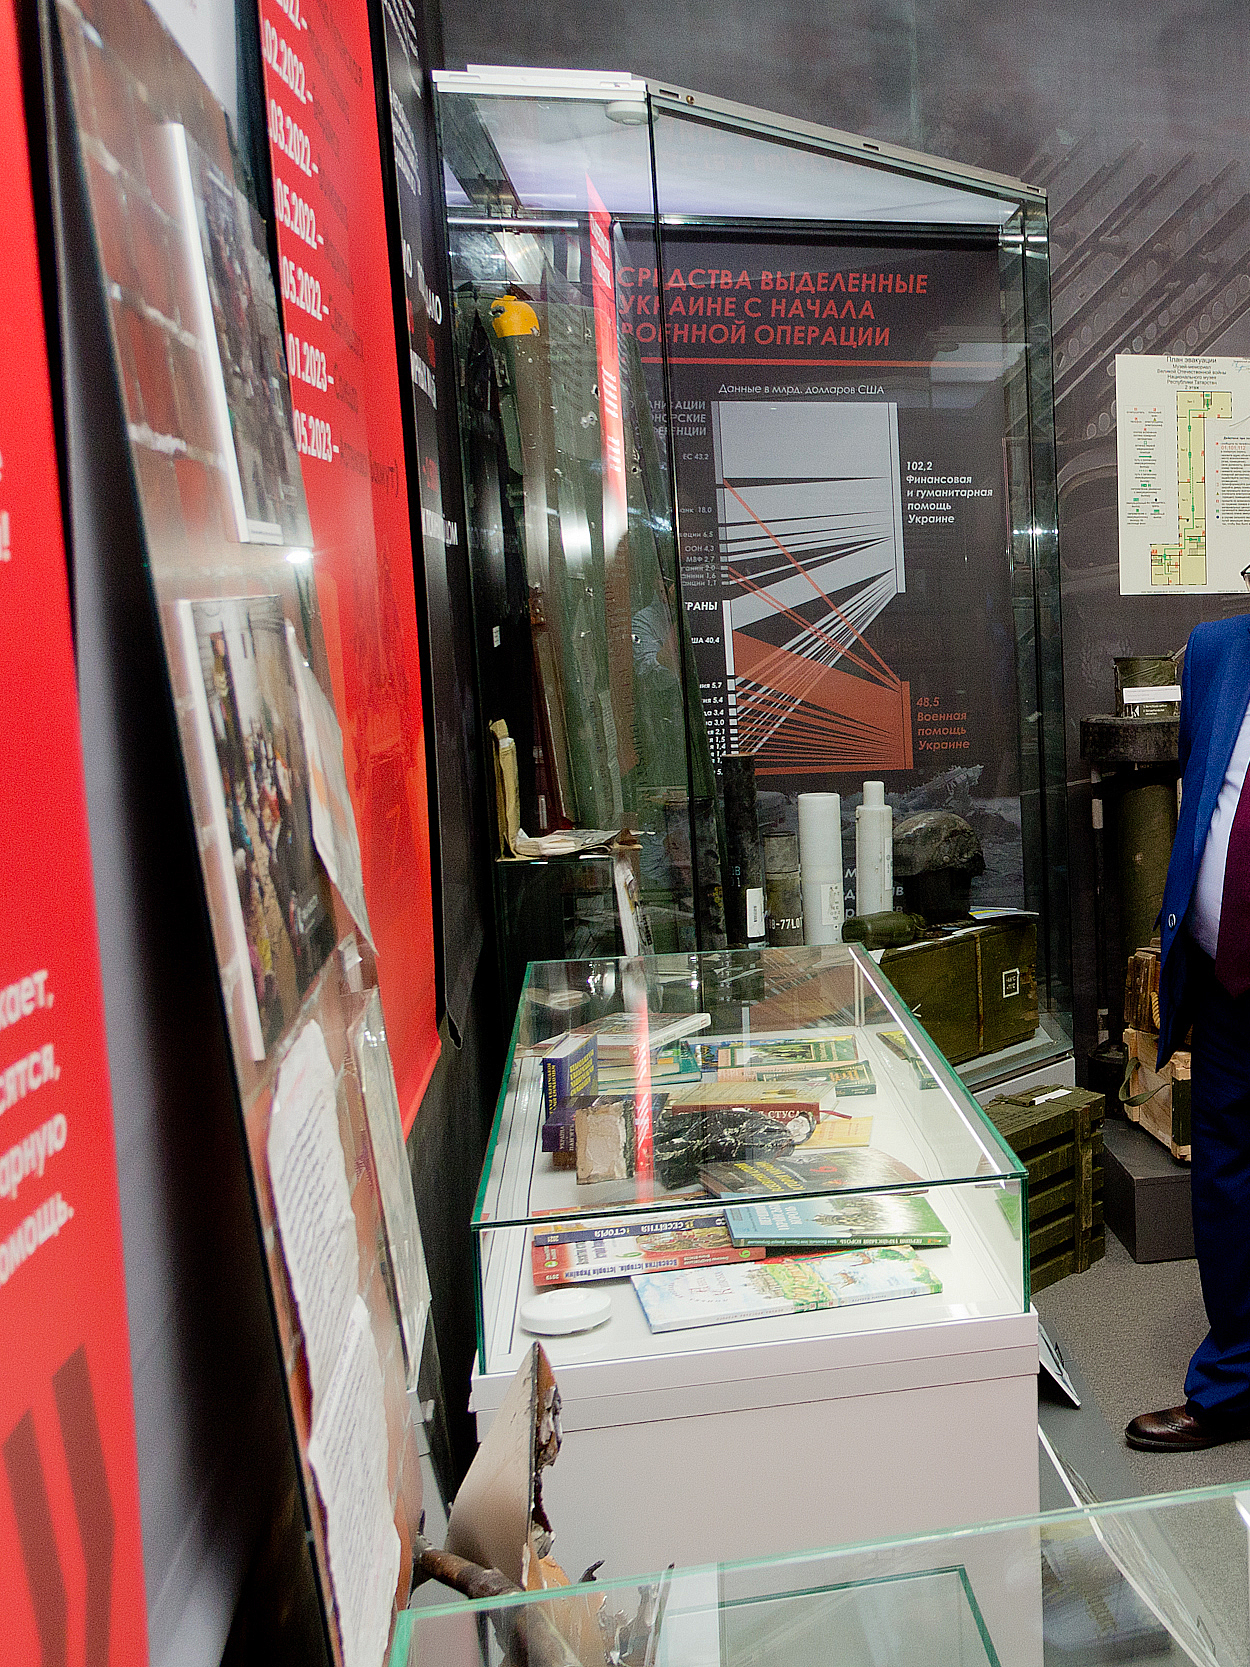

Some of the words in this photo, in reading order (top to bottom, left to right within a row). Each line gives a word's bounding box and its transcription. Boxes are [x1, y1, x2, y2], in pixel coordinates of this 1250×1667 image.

[760, 270, 928, 294] ВЫДЕЛЕННЫЕ
[744, 297, 762, 318] С
[771, 298, 875, 320] НАЧАЛА
[754, 324, 890, 349] ОПЕРАЦИИ
[718, 383, 762, 394] Данные
[764, 386, 770, 394] в
[772, 385, 803, 396] млрд.
[804, 385, 856, 396] долларов
[857, 384, 885, 395] США
[906, 461, 933, 471] 102,2
[906, 475, 972, 484] Финансовая
[906, 489, 913, 498] и
[916, 488, 993, 499] гуманитарная
[907, 502, 952, 511] помощь
[908, 514, 955, 525] Украине
[685, 601, 718, 611] РАНЫ
[916, 696, 940, 708] 48,5
[917, 711, 967, 722] Военная
[917, 726, 967, 736] помощь
[918, 740, 970, 752] Украине
